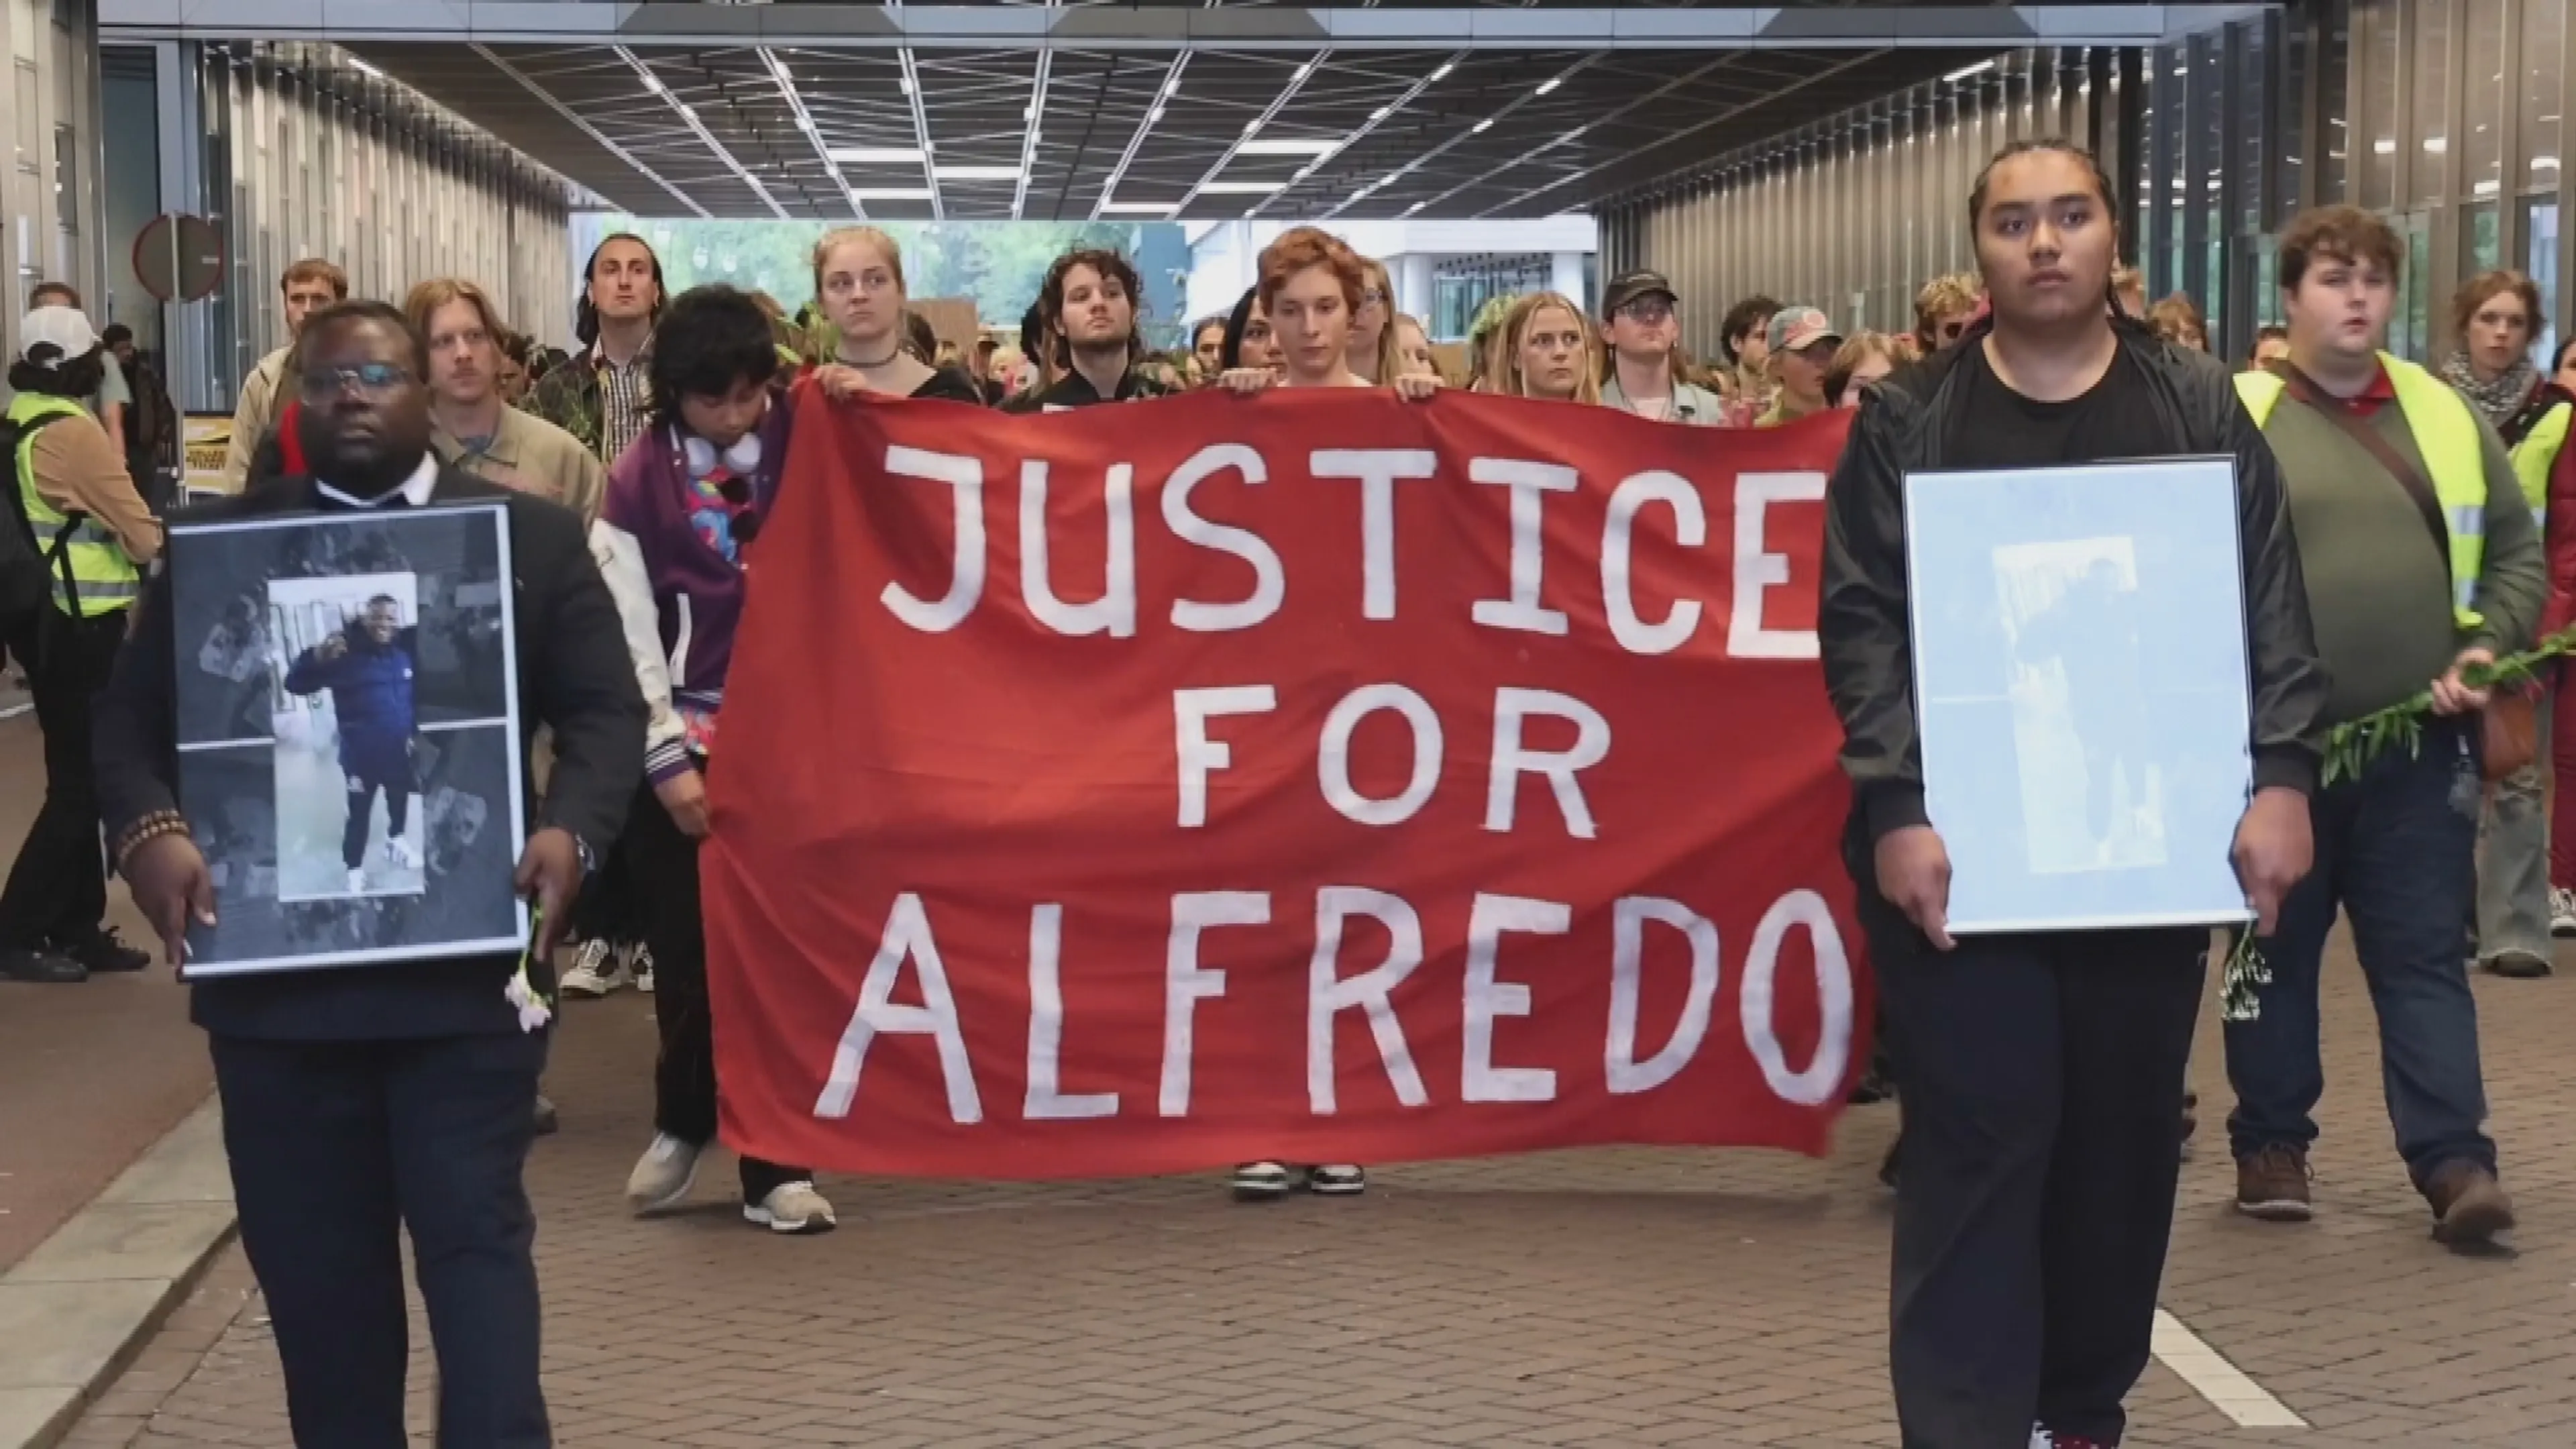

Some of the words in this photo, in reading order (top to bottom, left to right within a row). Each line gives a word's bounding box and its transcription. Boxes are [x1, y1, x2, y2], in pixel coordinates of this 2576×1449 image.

[880, 443, 1826, 659] JUSTICE
[1173, 684, 1610, 838] FOR
[814, 886, 1852, 1123] ALFREDO
